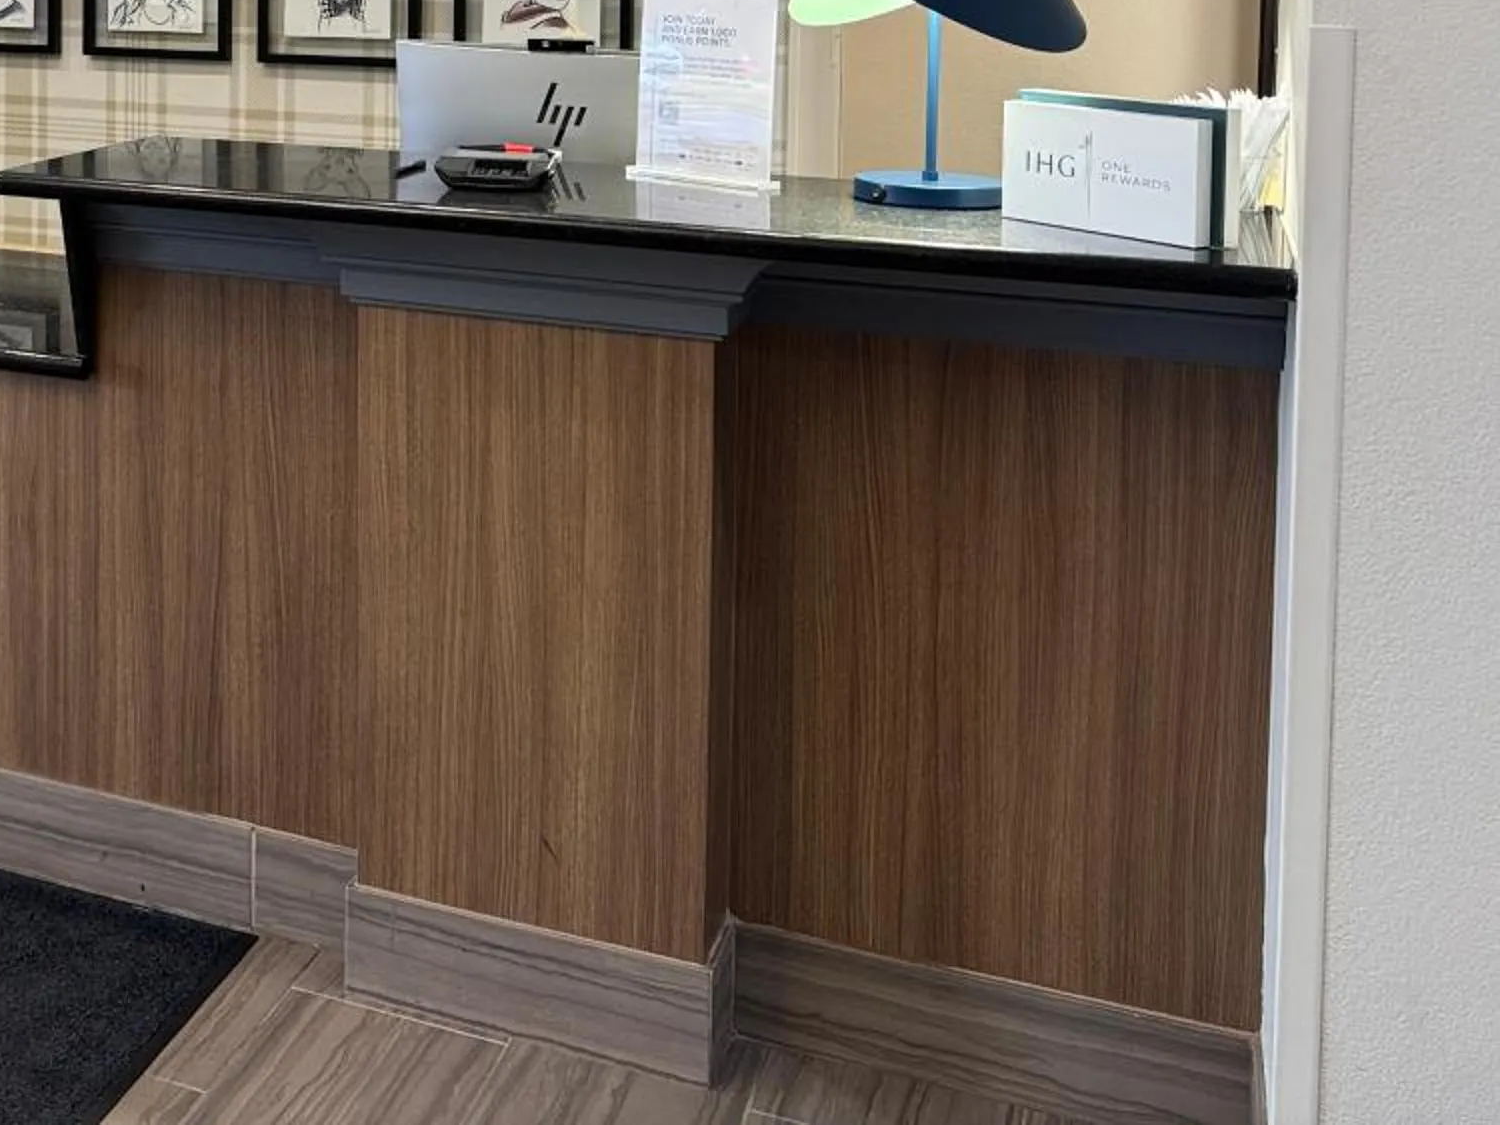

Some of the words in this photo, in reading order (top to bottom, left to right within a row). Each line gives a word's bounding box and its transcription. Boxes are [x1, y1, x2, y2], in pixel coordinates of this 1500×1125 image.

[537, 82, 588, 148] hp
[1025, 150, 1076, 178] IHG
[1101, 159, 1132, 174] ONE
[1101, 174, 1171, 193] REWARDS
